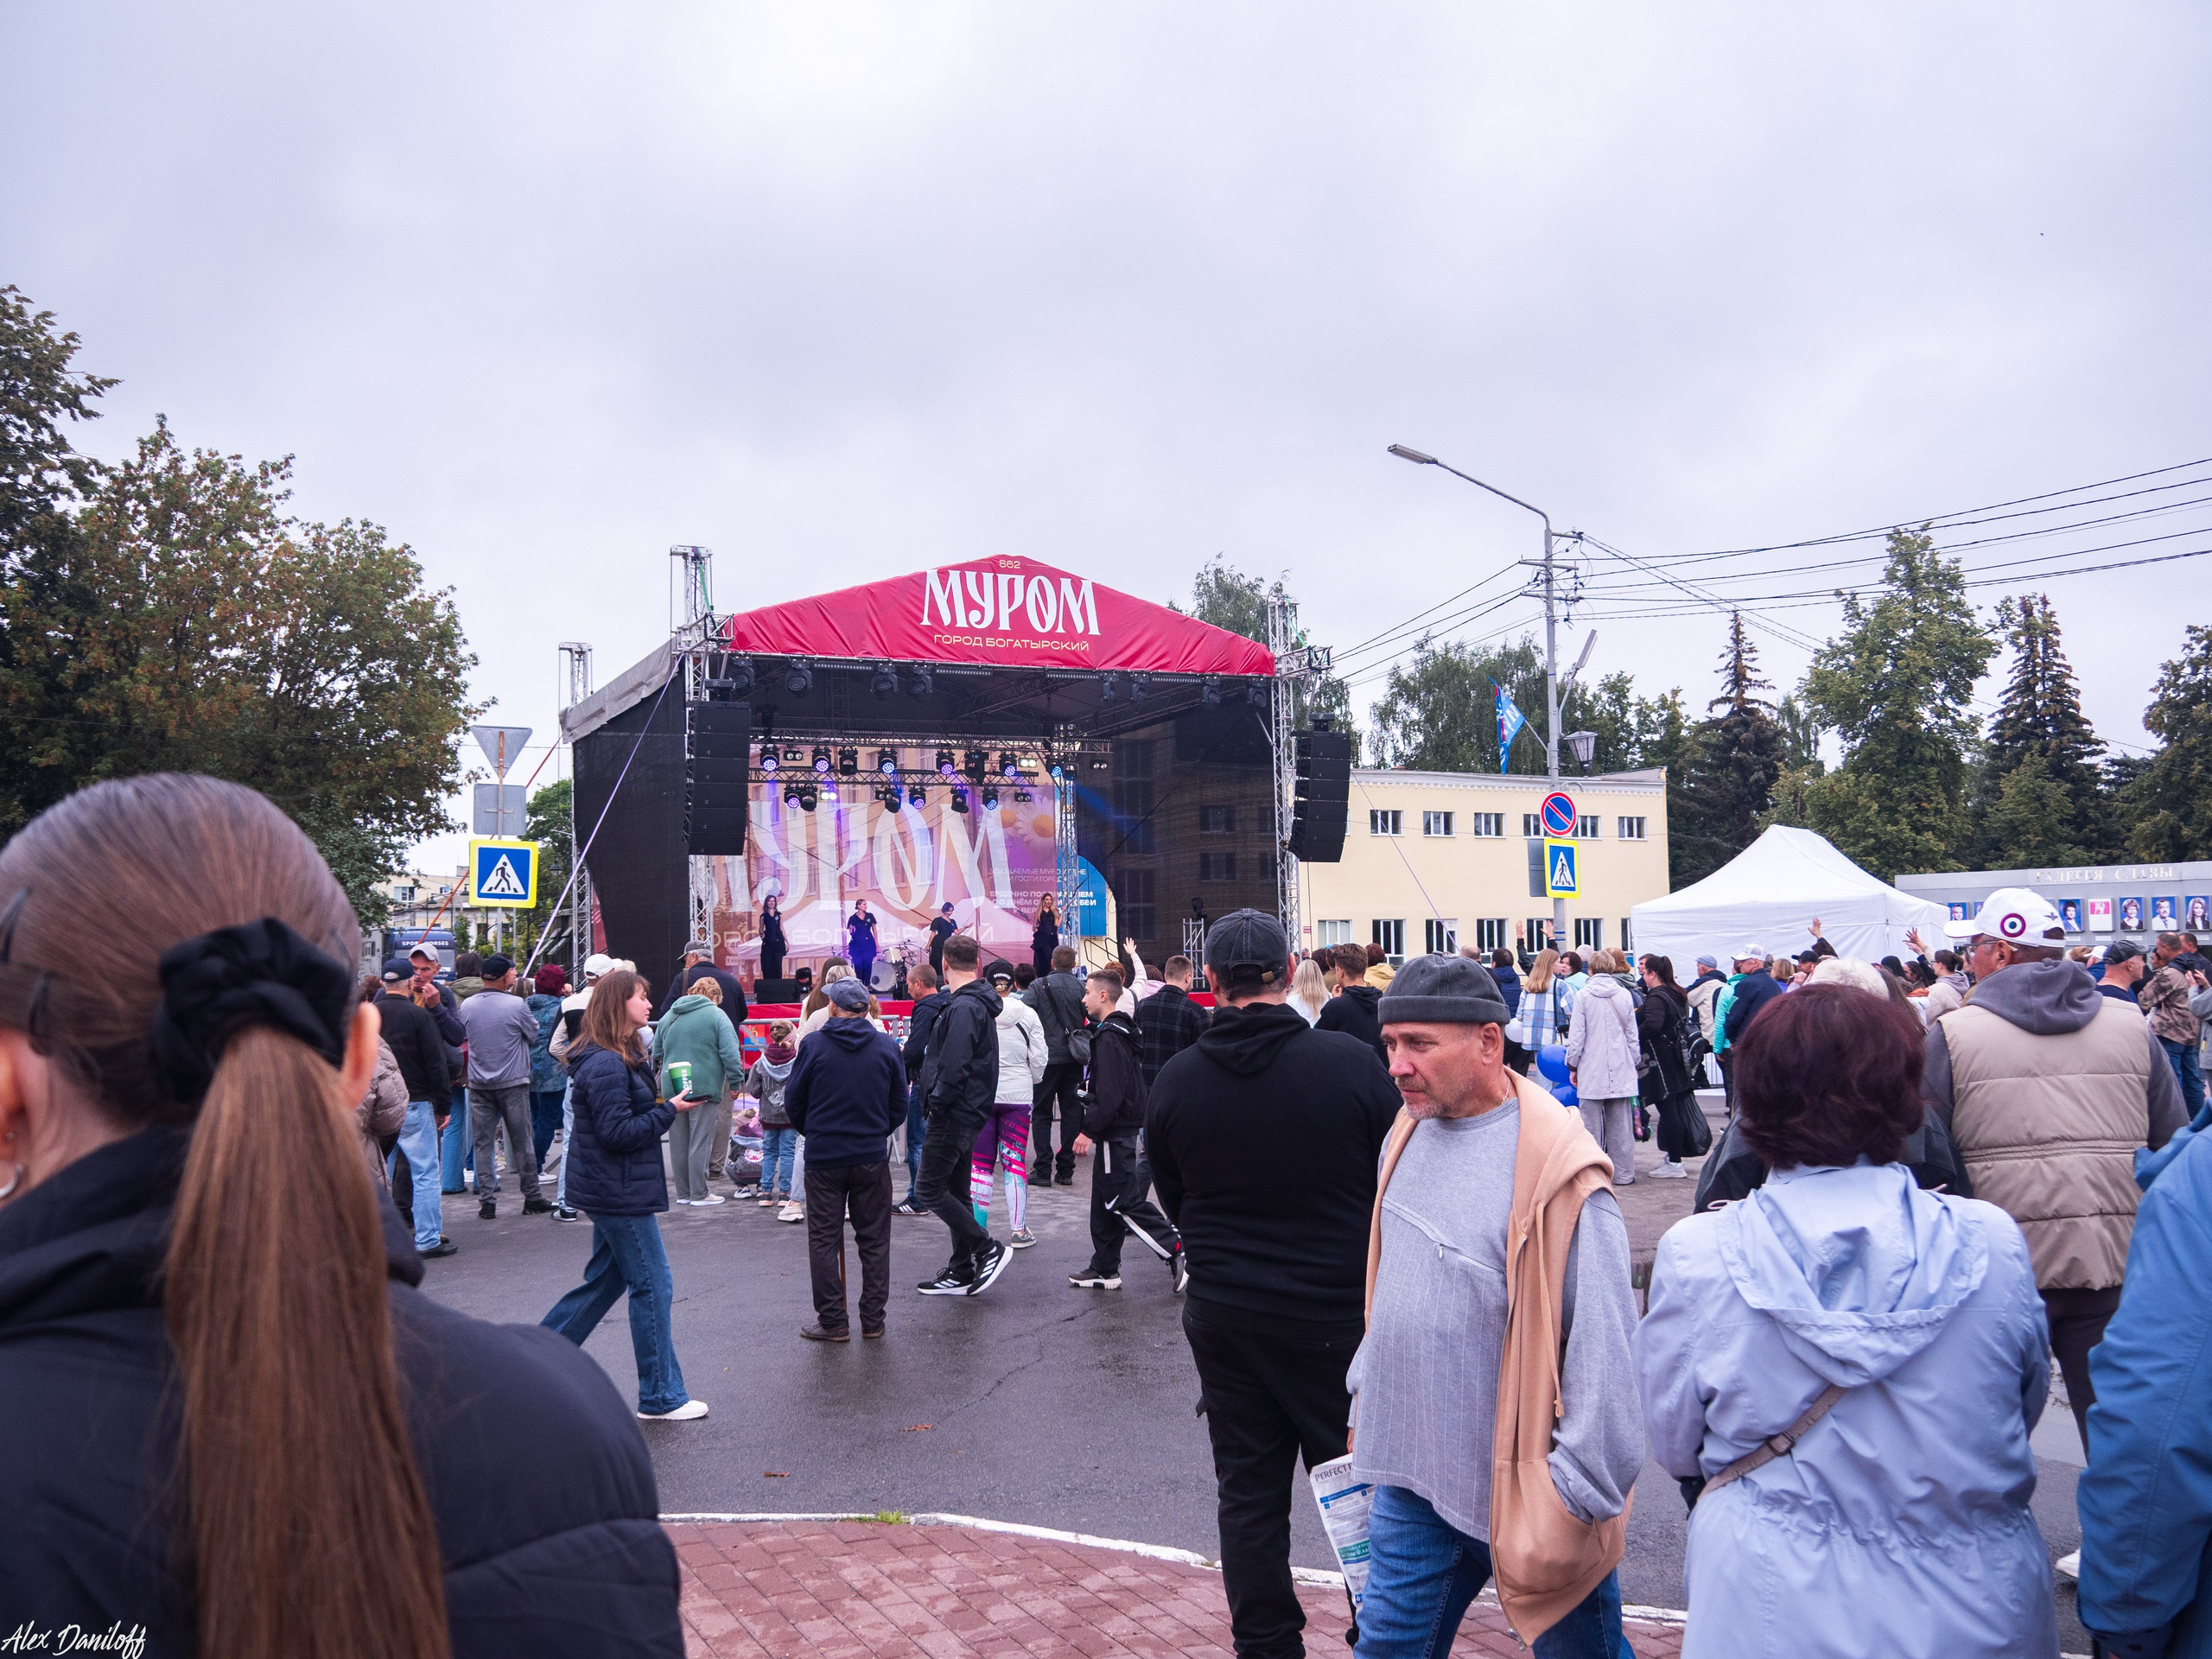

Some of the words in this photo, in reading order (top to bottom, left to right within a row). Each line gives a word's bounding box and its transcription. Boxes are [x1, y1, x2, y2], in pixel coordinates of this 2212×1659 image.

[999, 559, 1021, 569] 862
[919, 569, 1101, 635] МУРОМ
[934, 634, 983, 647] ГОРОД
[986, 637, 1090, 652] БОГАТЫРСКИЙ
[2114, 866, 2174, 880] СЛАВЫ
[1314, 1464, 1348, 1482] PERFECT
